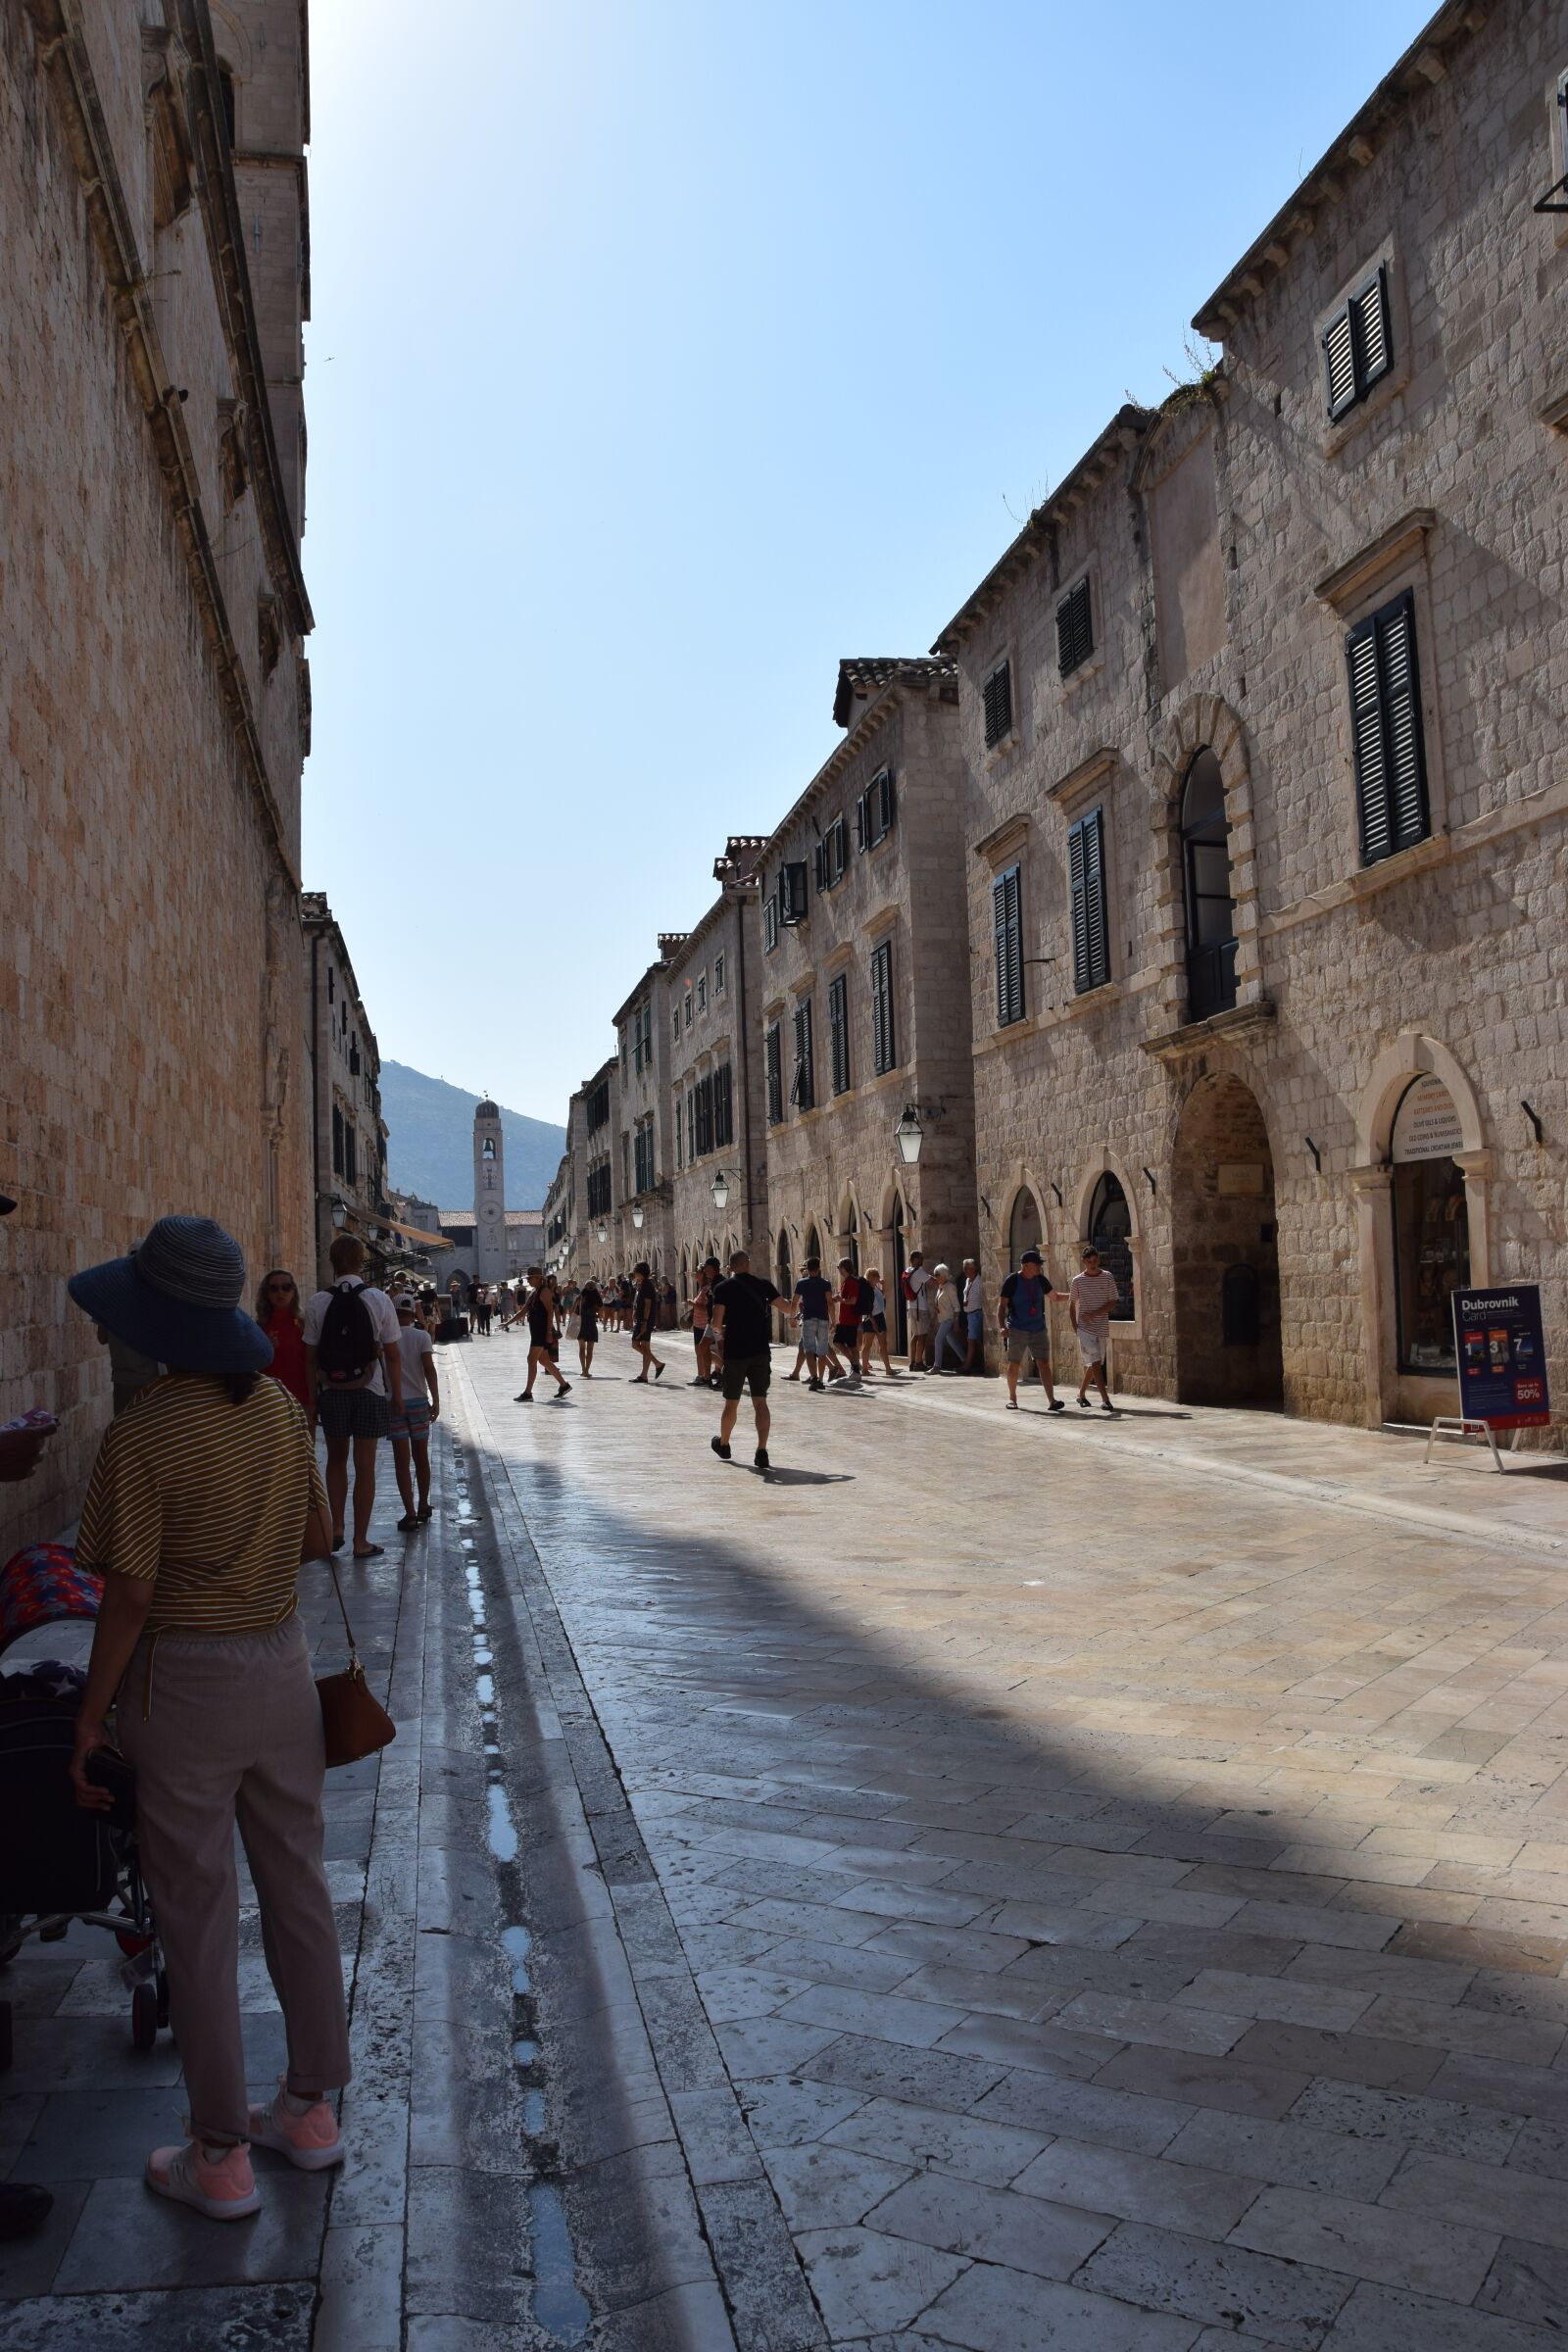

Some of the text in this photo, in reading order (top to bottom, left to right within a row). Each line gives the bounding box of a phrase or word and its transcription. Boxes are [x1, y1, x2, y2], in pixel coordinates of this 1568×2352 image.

[1461, 1296, 1520, 1311] Dubrovnik
[1462, 1310, 1487, 1322] Card
[1465, 1343, 1472, 1355] 1
[1489, 1341, 1498, 1353] 3
[1513, 1339, 1523, 1351] 7
[1517, 1389, 1541, 1399] 50%
